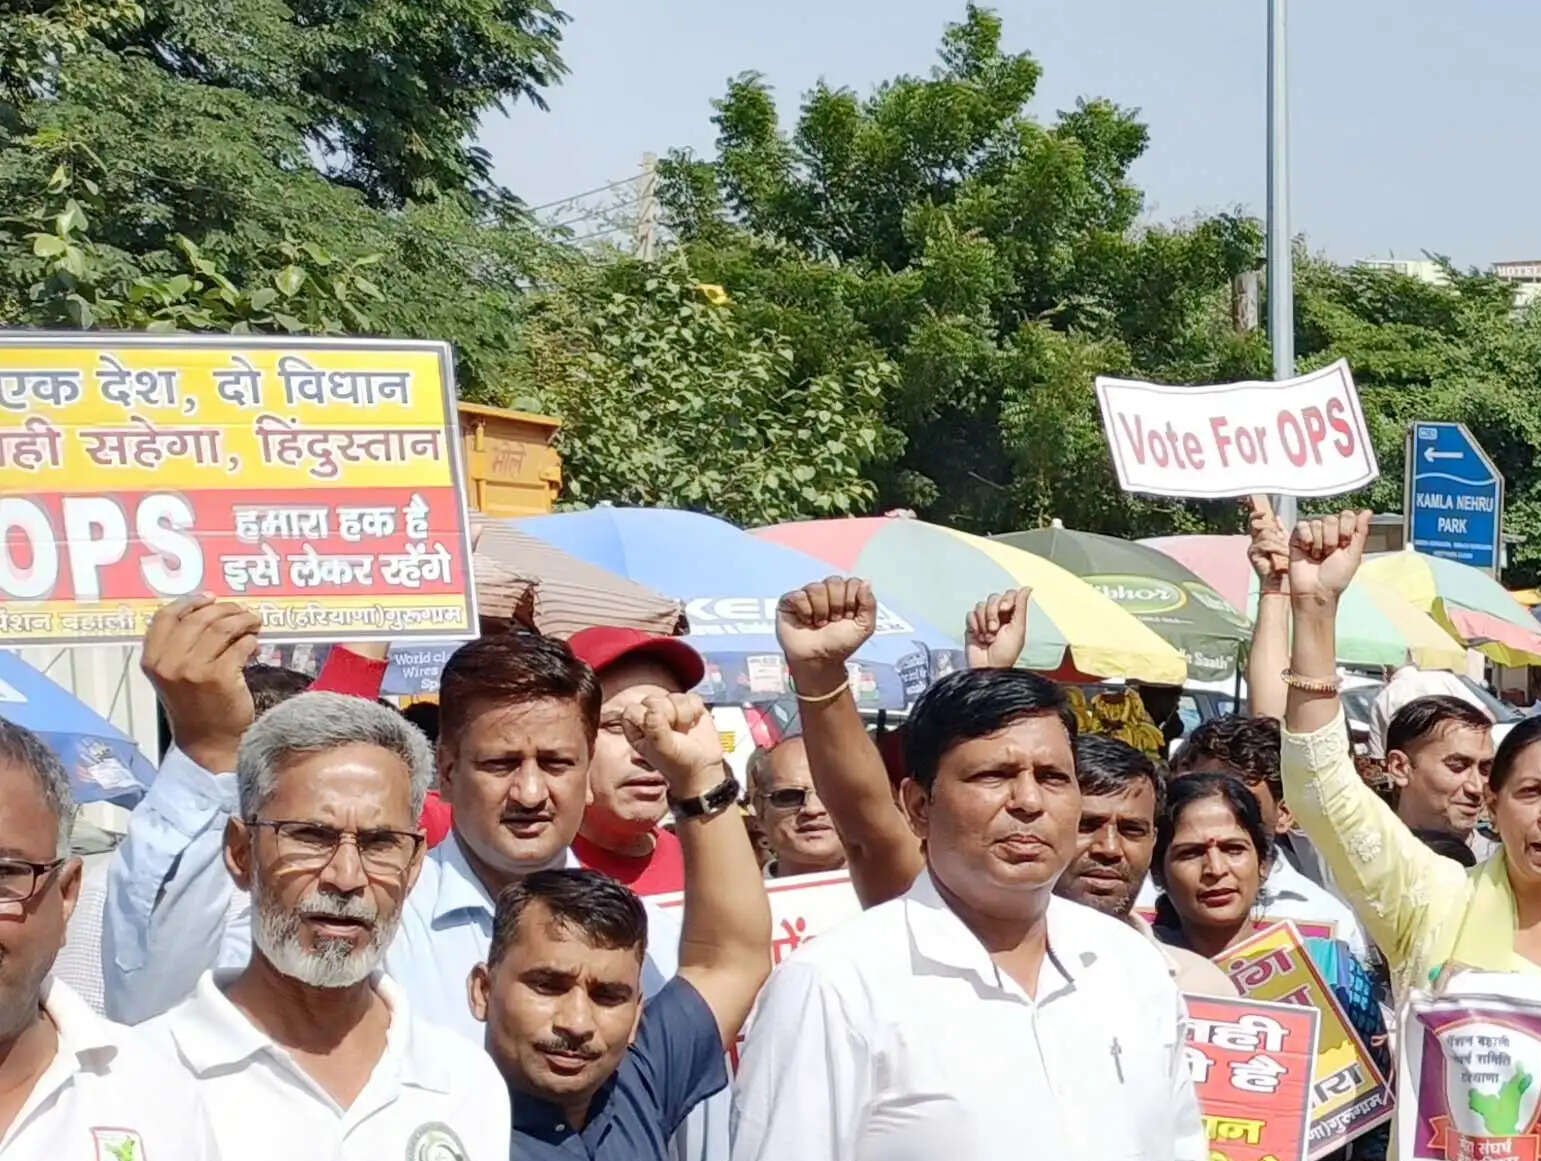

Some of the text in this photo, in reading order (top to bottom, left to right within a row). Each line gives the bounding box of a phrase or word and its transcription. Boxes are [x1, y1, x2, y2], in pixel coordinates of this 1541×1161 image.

[0, 357, 411, 413] एक देश, दो विधान
[80, 416, 239, 471] सहेगा,
[256, 415, 442, 477] हिंदुस्तान
[1118, 397, 1356, 470] Vote For OPS
[233, 493, 430, 541] हमारा हक है
[1416, 493, 1494, 513] KAMLA NEHRU
[1437, 517, 1468, 533] PARK
[0, 493, 203, 603] OPS
[219, 541, 452, 592] इसे लेकर रहेंगे
[1097, 584, 1171, 601] bhor
[395, 652, 431, 665] World
[402, 667, 438, 679] Wires
[1227, 1053, 1289, 1093] है
